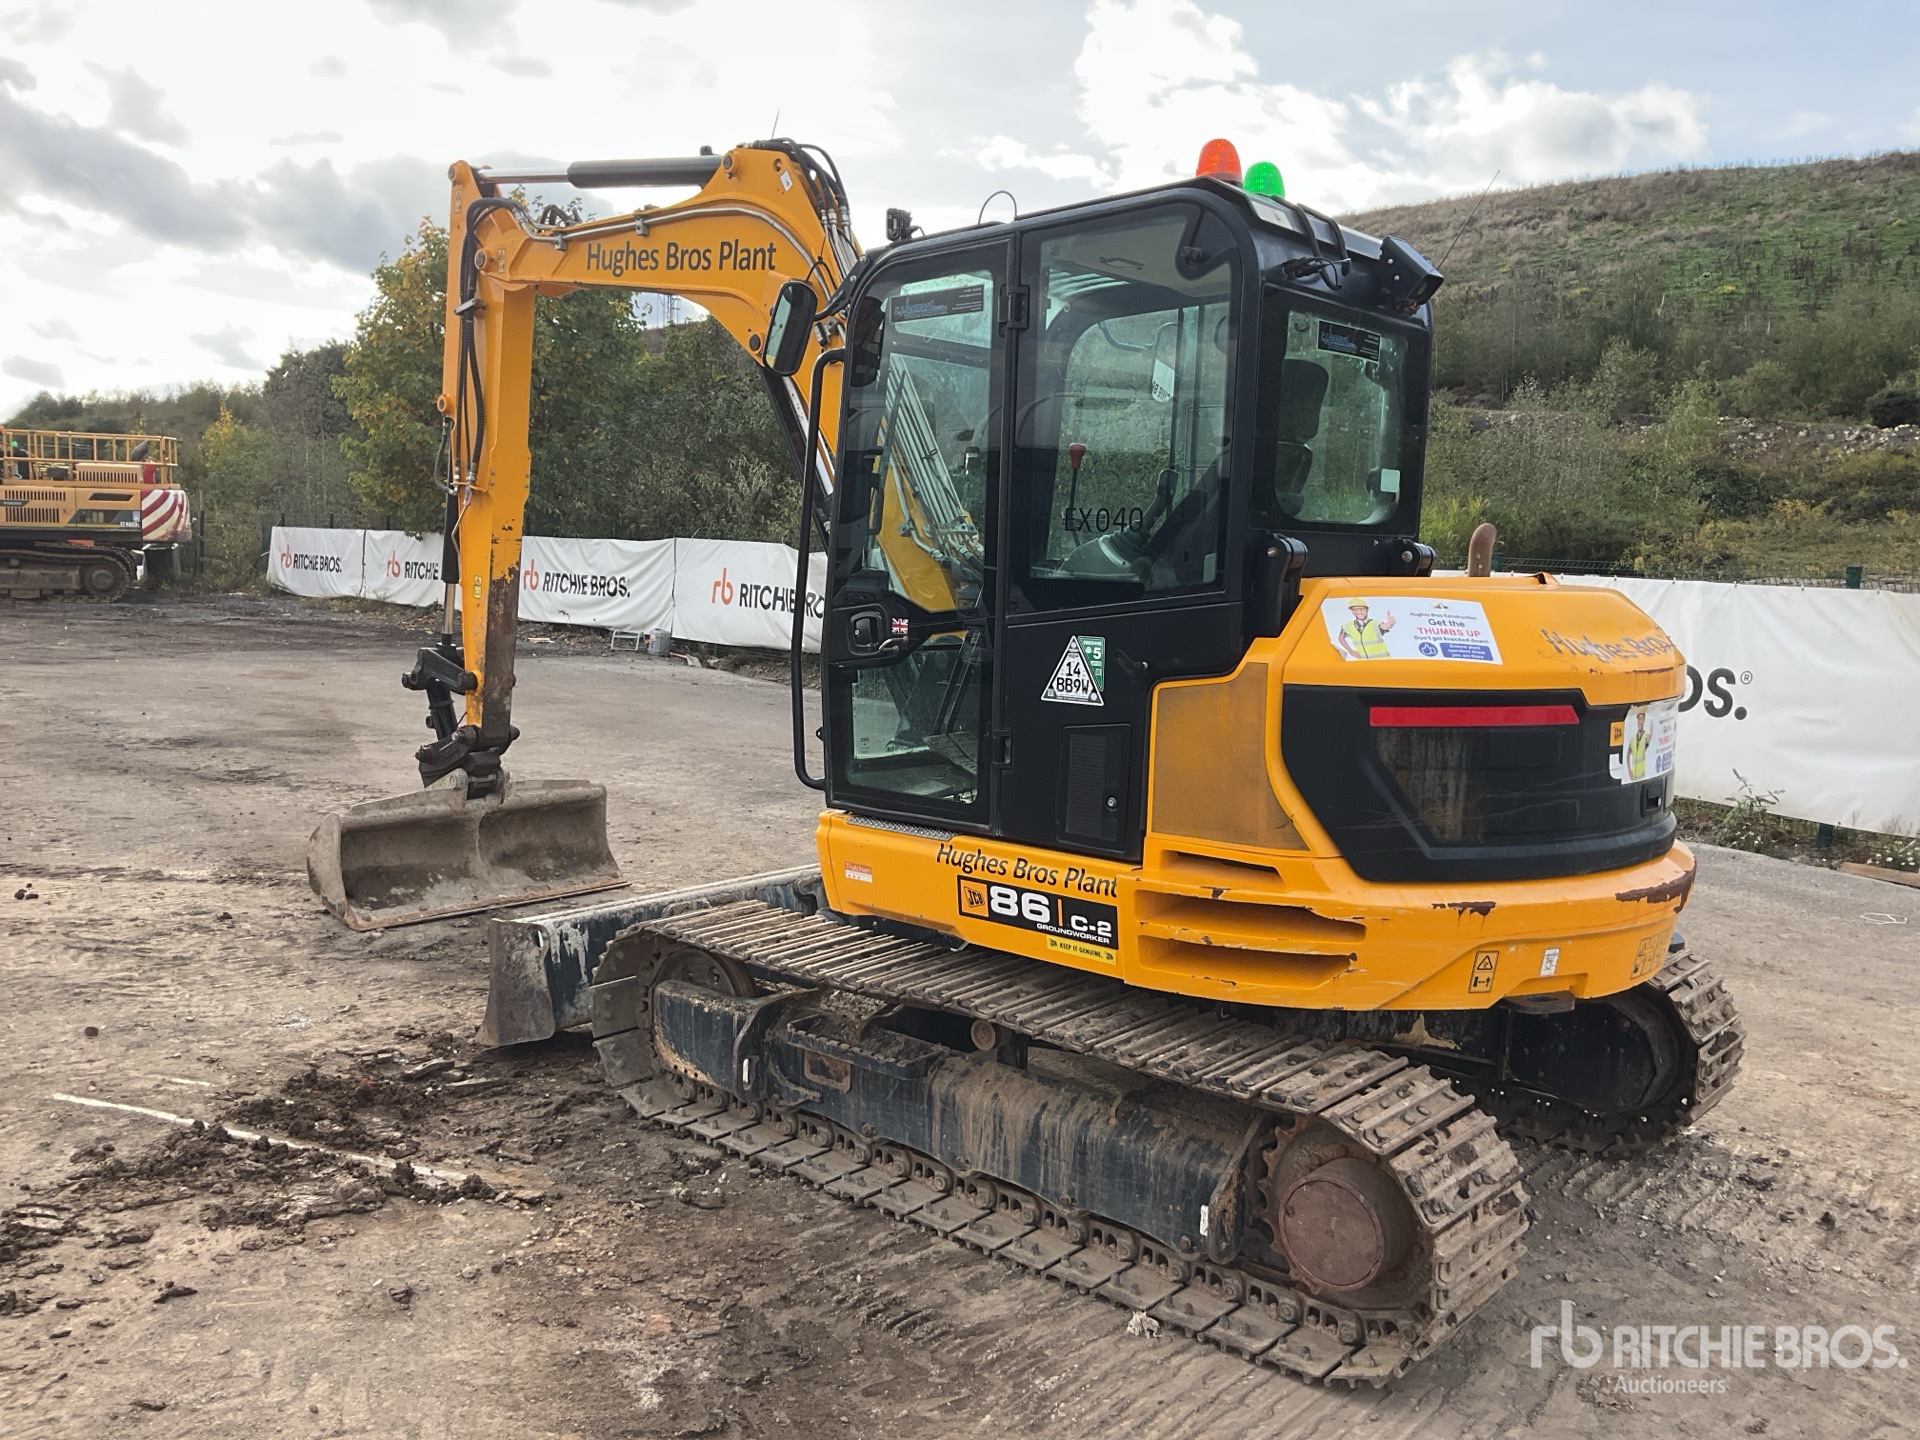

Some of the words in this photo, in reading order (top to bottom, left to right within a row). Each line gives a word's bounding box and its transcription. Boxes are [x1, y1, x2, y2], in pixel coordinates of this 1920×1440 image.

[587, 241, 659, 277] Hughes
[666, 242, 711, 271] Bros
[719, 239, 777, 271] Plant
[1064, 507, 1143, 532] EX040
[293, 553, 318, 571] RITCHIE
[320, 555, 342, 573] BROS.
[404, 561, 438, 580] RITCHIE
[543, 572, 588, 595] RITCHIE
[590, 575, 631, 598] BROS.
[1417, 627, 1464, 636] THUMBS
[1428, 618, 1447, 627] Get
[1449, 619, 1465, 627] the
[1093, 647, 1102, 660] 5
[1066, 662, 1081, 677] 14
[1056, 677, 1089, 695] BB9W
[936, 843, 1008, 875] Hughes
[1013, 858, 1058, 886] Bros
[1064, 867, 1117, 898] Plant
[967, 888, 984, 906] JCB
[990, 885, 1050, 923] 86
[1037, 923, 1110, 944] GROUNDWORKER
[1070, 915, 1112, 937] C-2
[1060, 942, 1071, 950] KEEP
